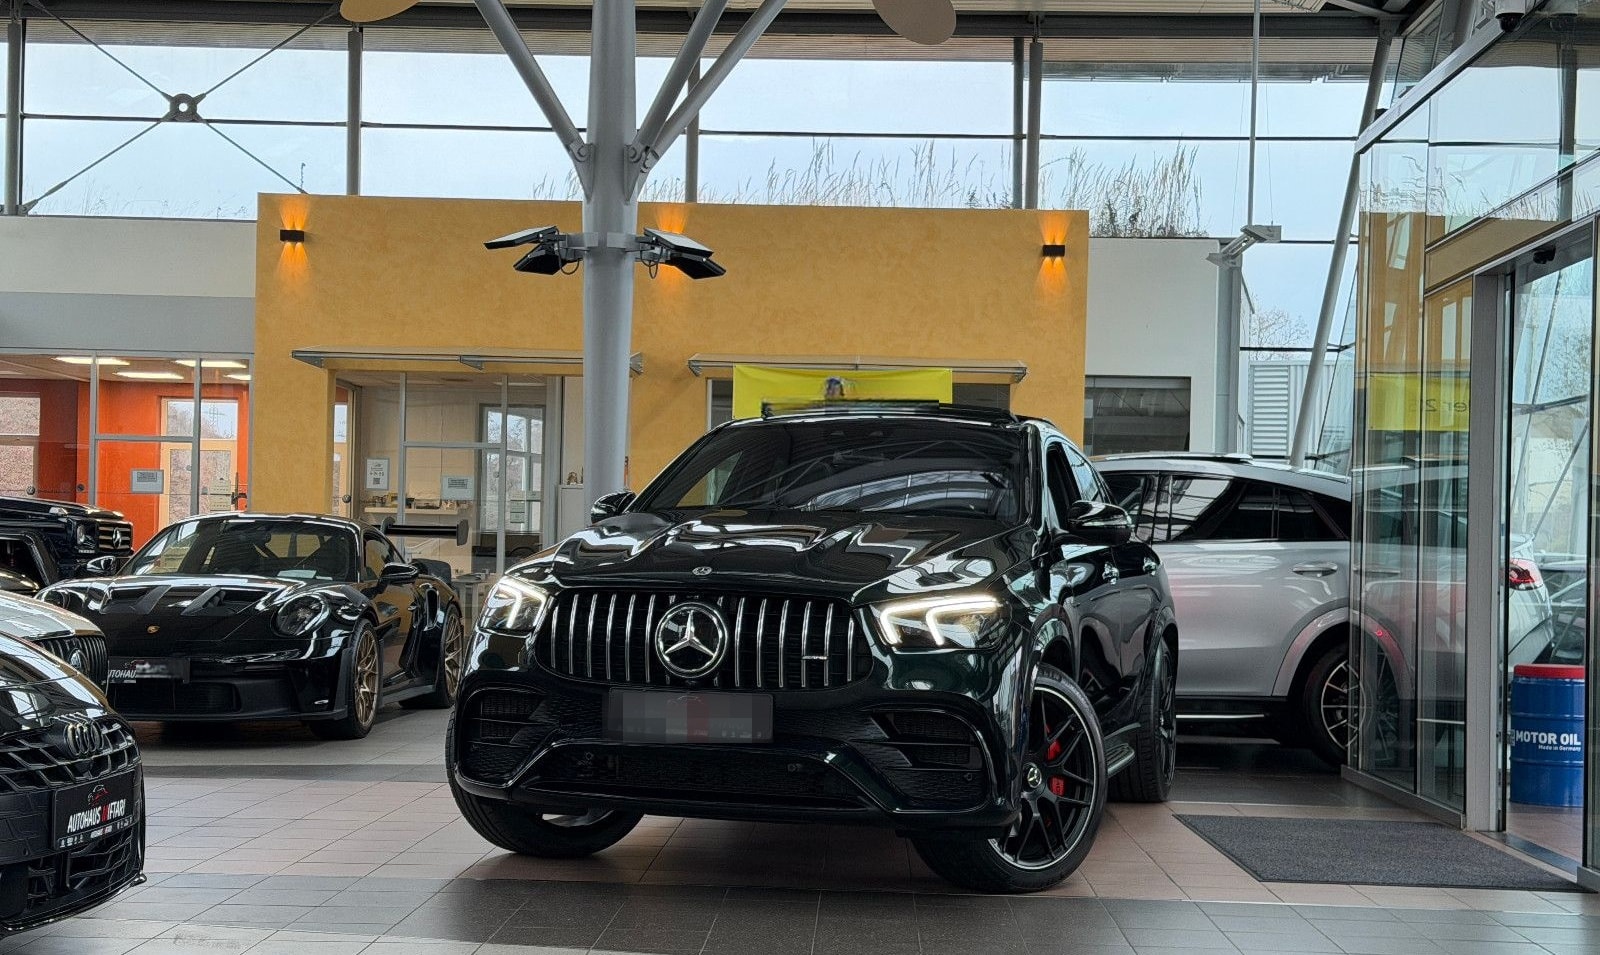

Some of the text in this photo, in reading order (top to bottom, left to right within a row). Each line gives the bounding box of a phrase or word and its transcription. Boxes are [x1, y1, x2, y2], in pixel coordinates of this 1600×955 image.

[1515, 730, 1558, 745] MOTOR
[1560, 733, 1581, 745] OIL
[67, 807, 102, 832] AUTOHAUS
